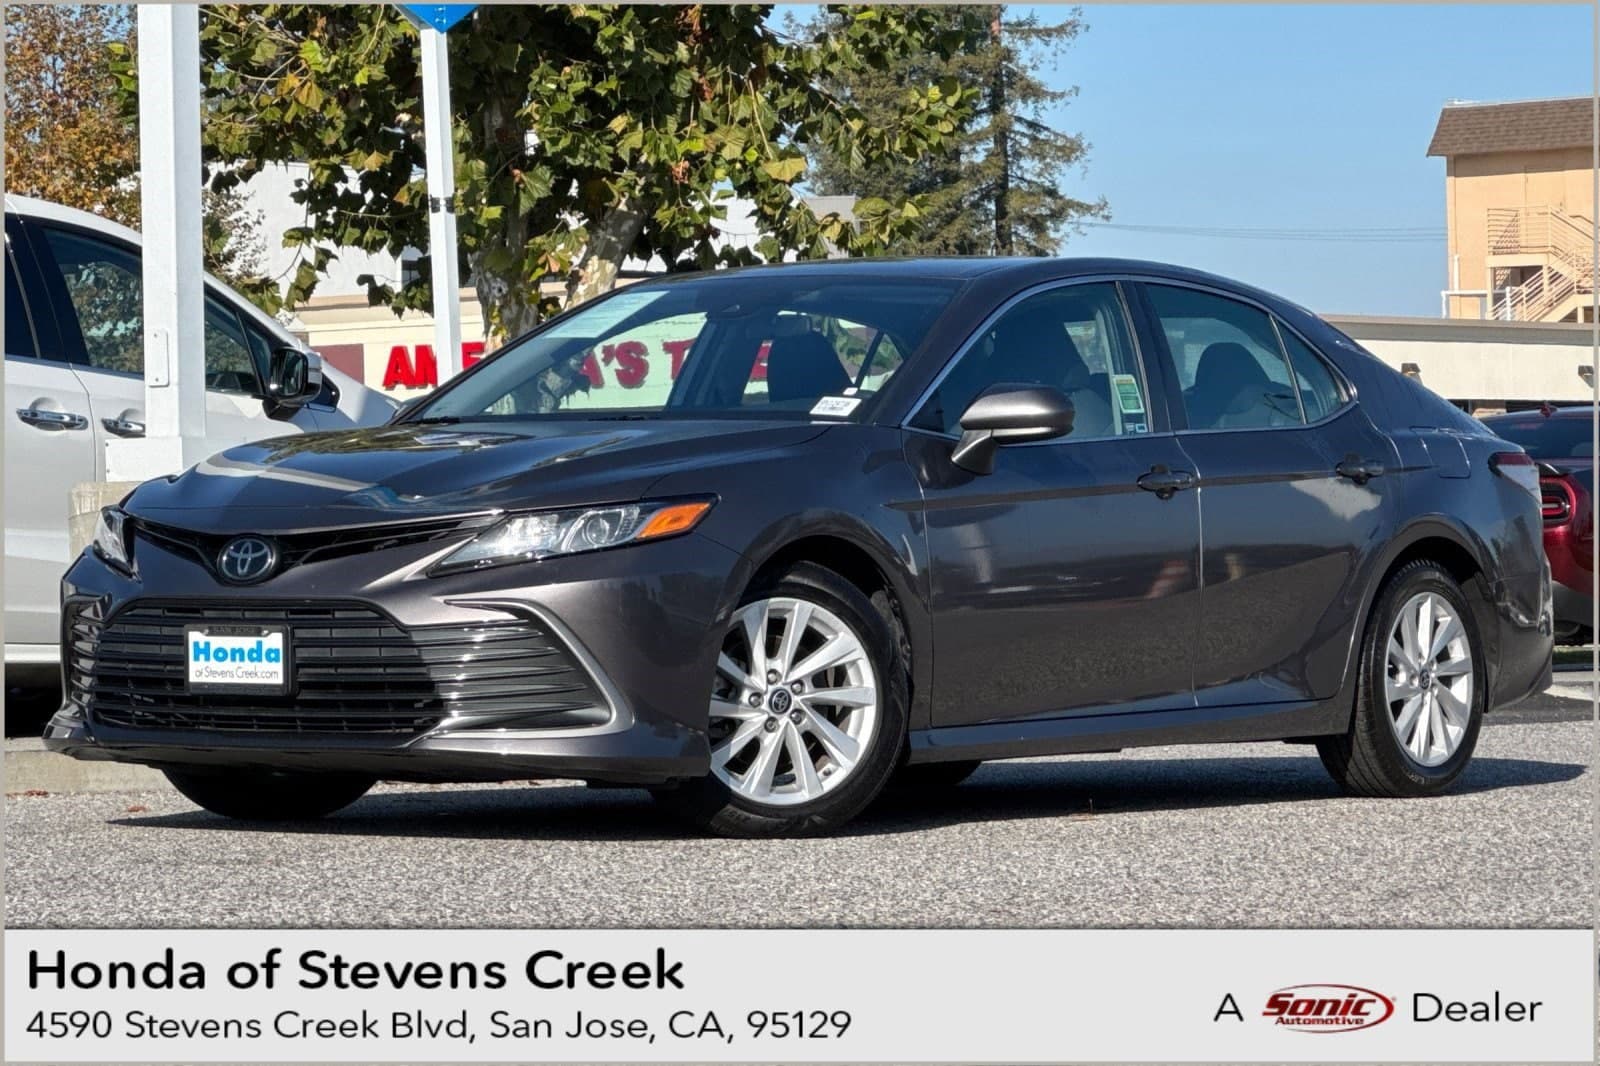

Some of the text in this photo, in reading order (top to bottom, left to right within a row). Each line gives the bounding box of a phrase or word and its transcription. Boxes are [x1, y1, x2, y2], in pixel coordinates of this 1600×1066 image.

[193, 640, 281, 663] Honda
[195, 665, 279, 680] of Stevens Creek.com
